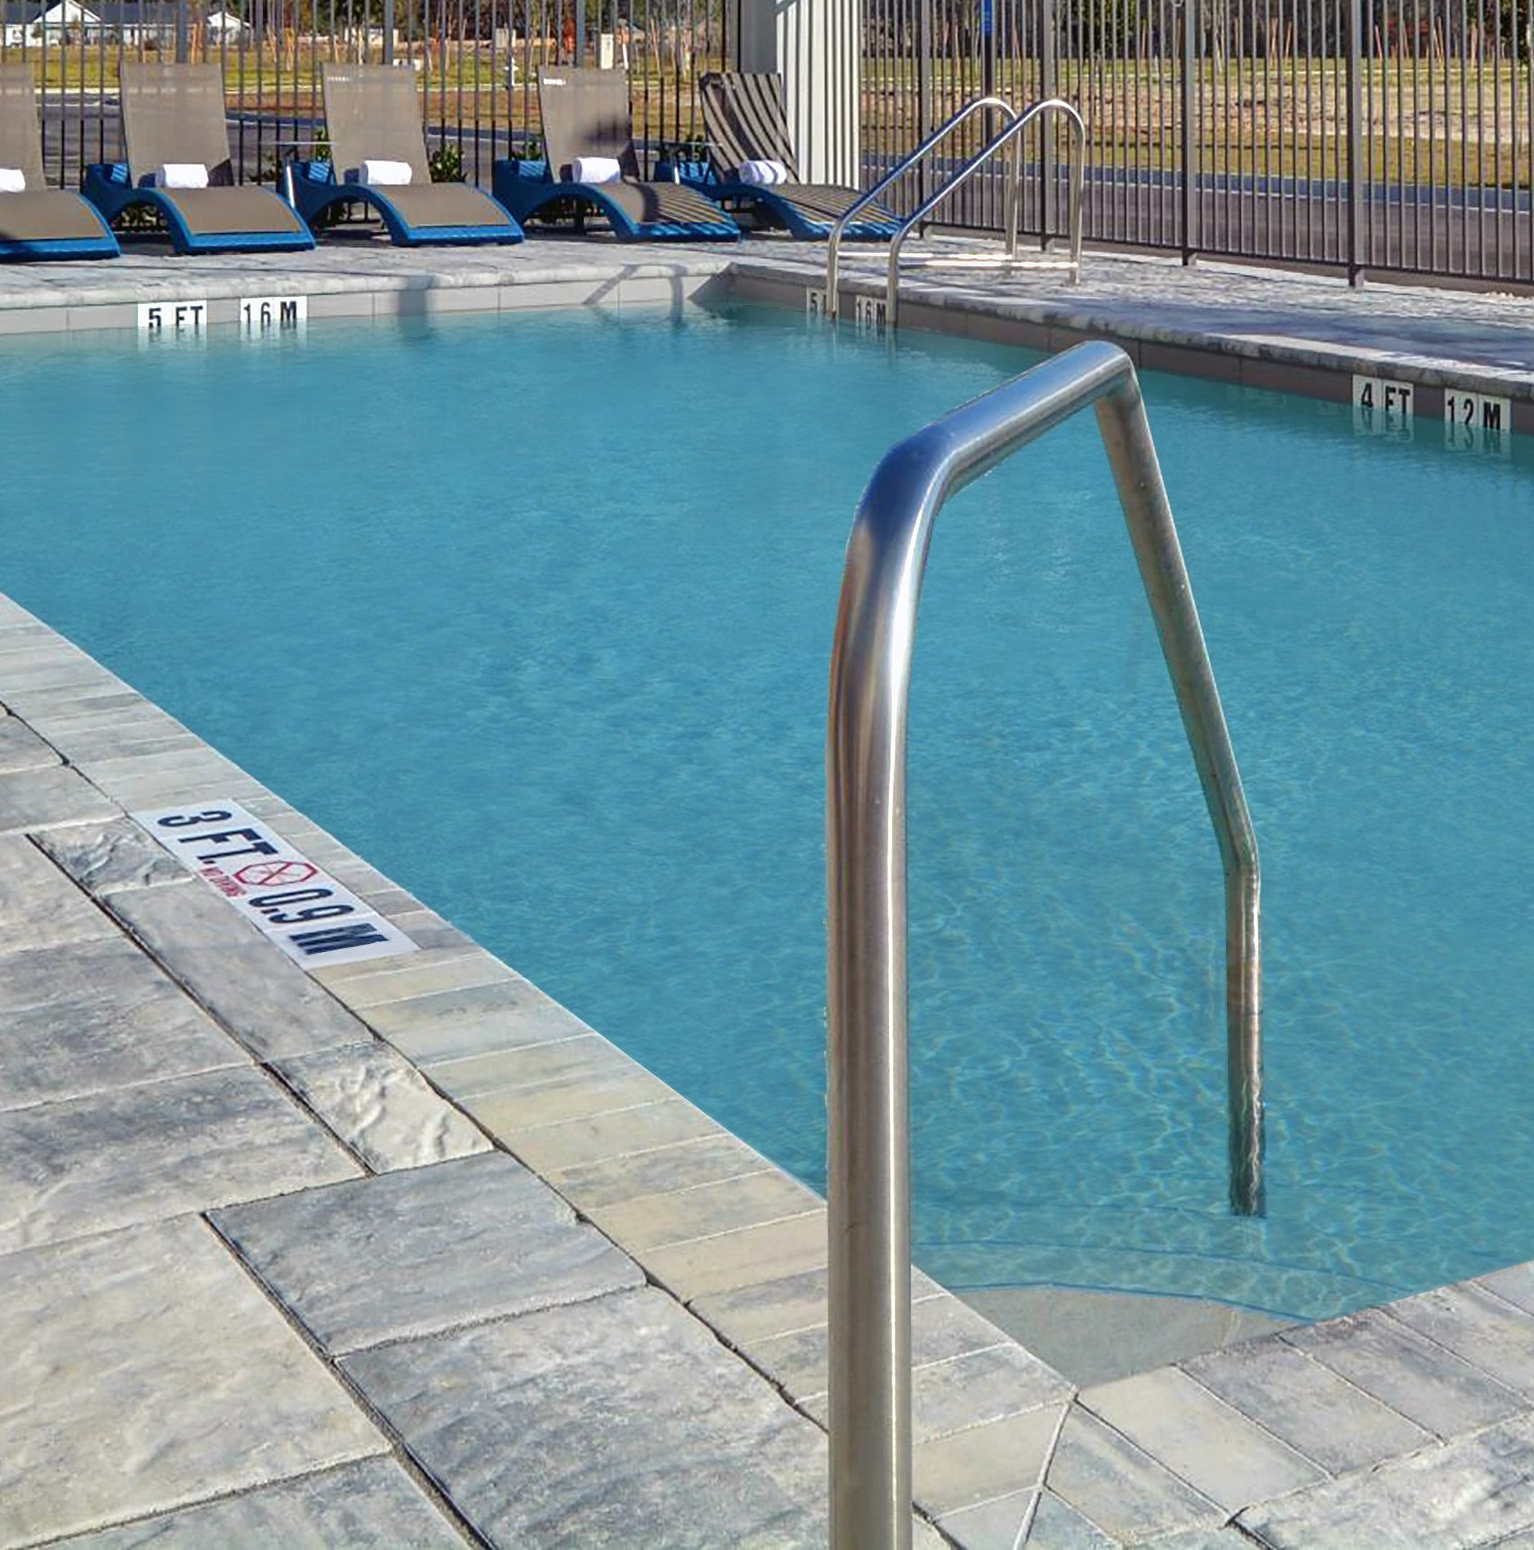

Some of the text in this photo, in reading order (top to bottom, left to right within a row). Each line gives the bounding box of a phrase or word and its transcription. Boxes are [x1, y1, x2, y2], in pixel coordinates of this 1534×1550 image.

[175, 304, 203, 327] FT
[279, 300, 297, 323] M
[1361, 382, 1410, 415] 4 FT
[1483, 401, 1501, 430] M
[157, 809, 233, 828] 3
[248, 888, 355, 925] 0.9
